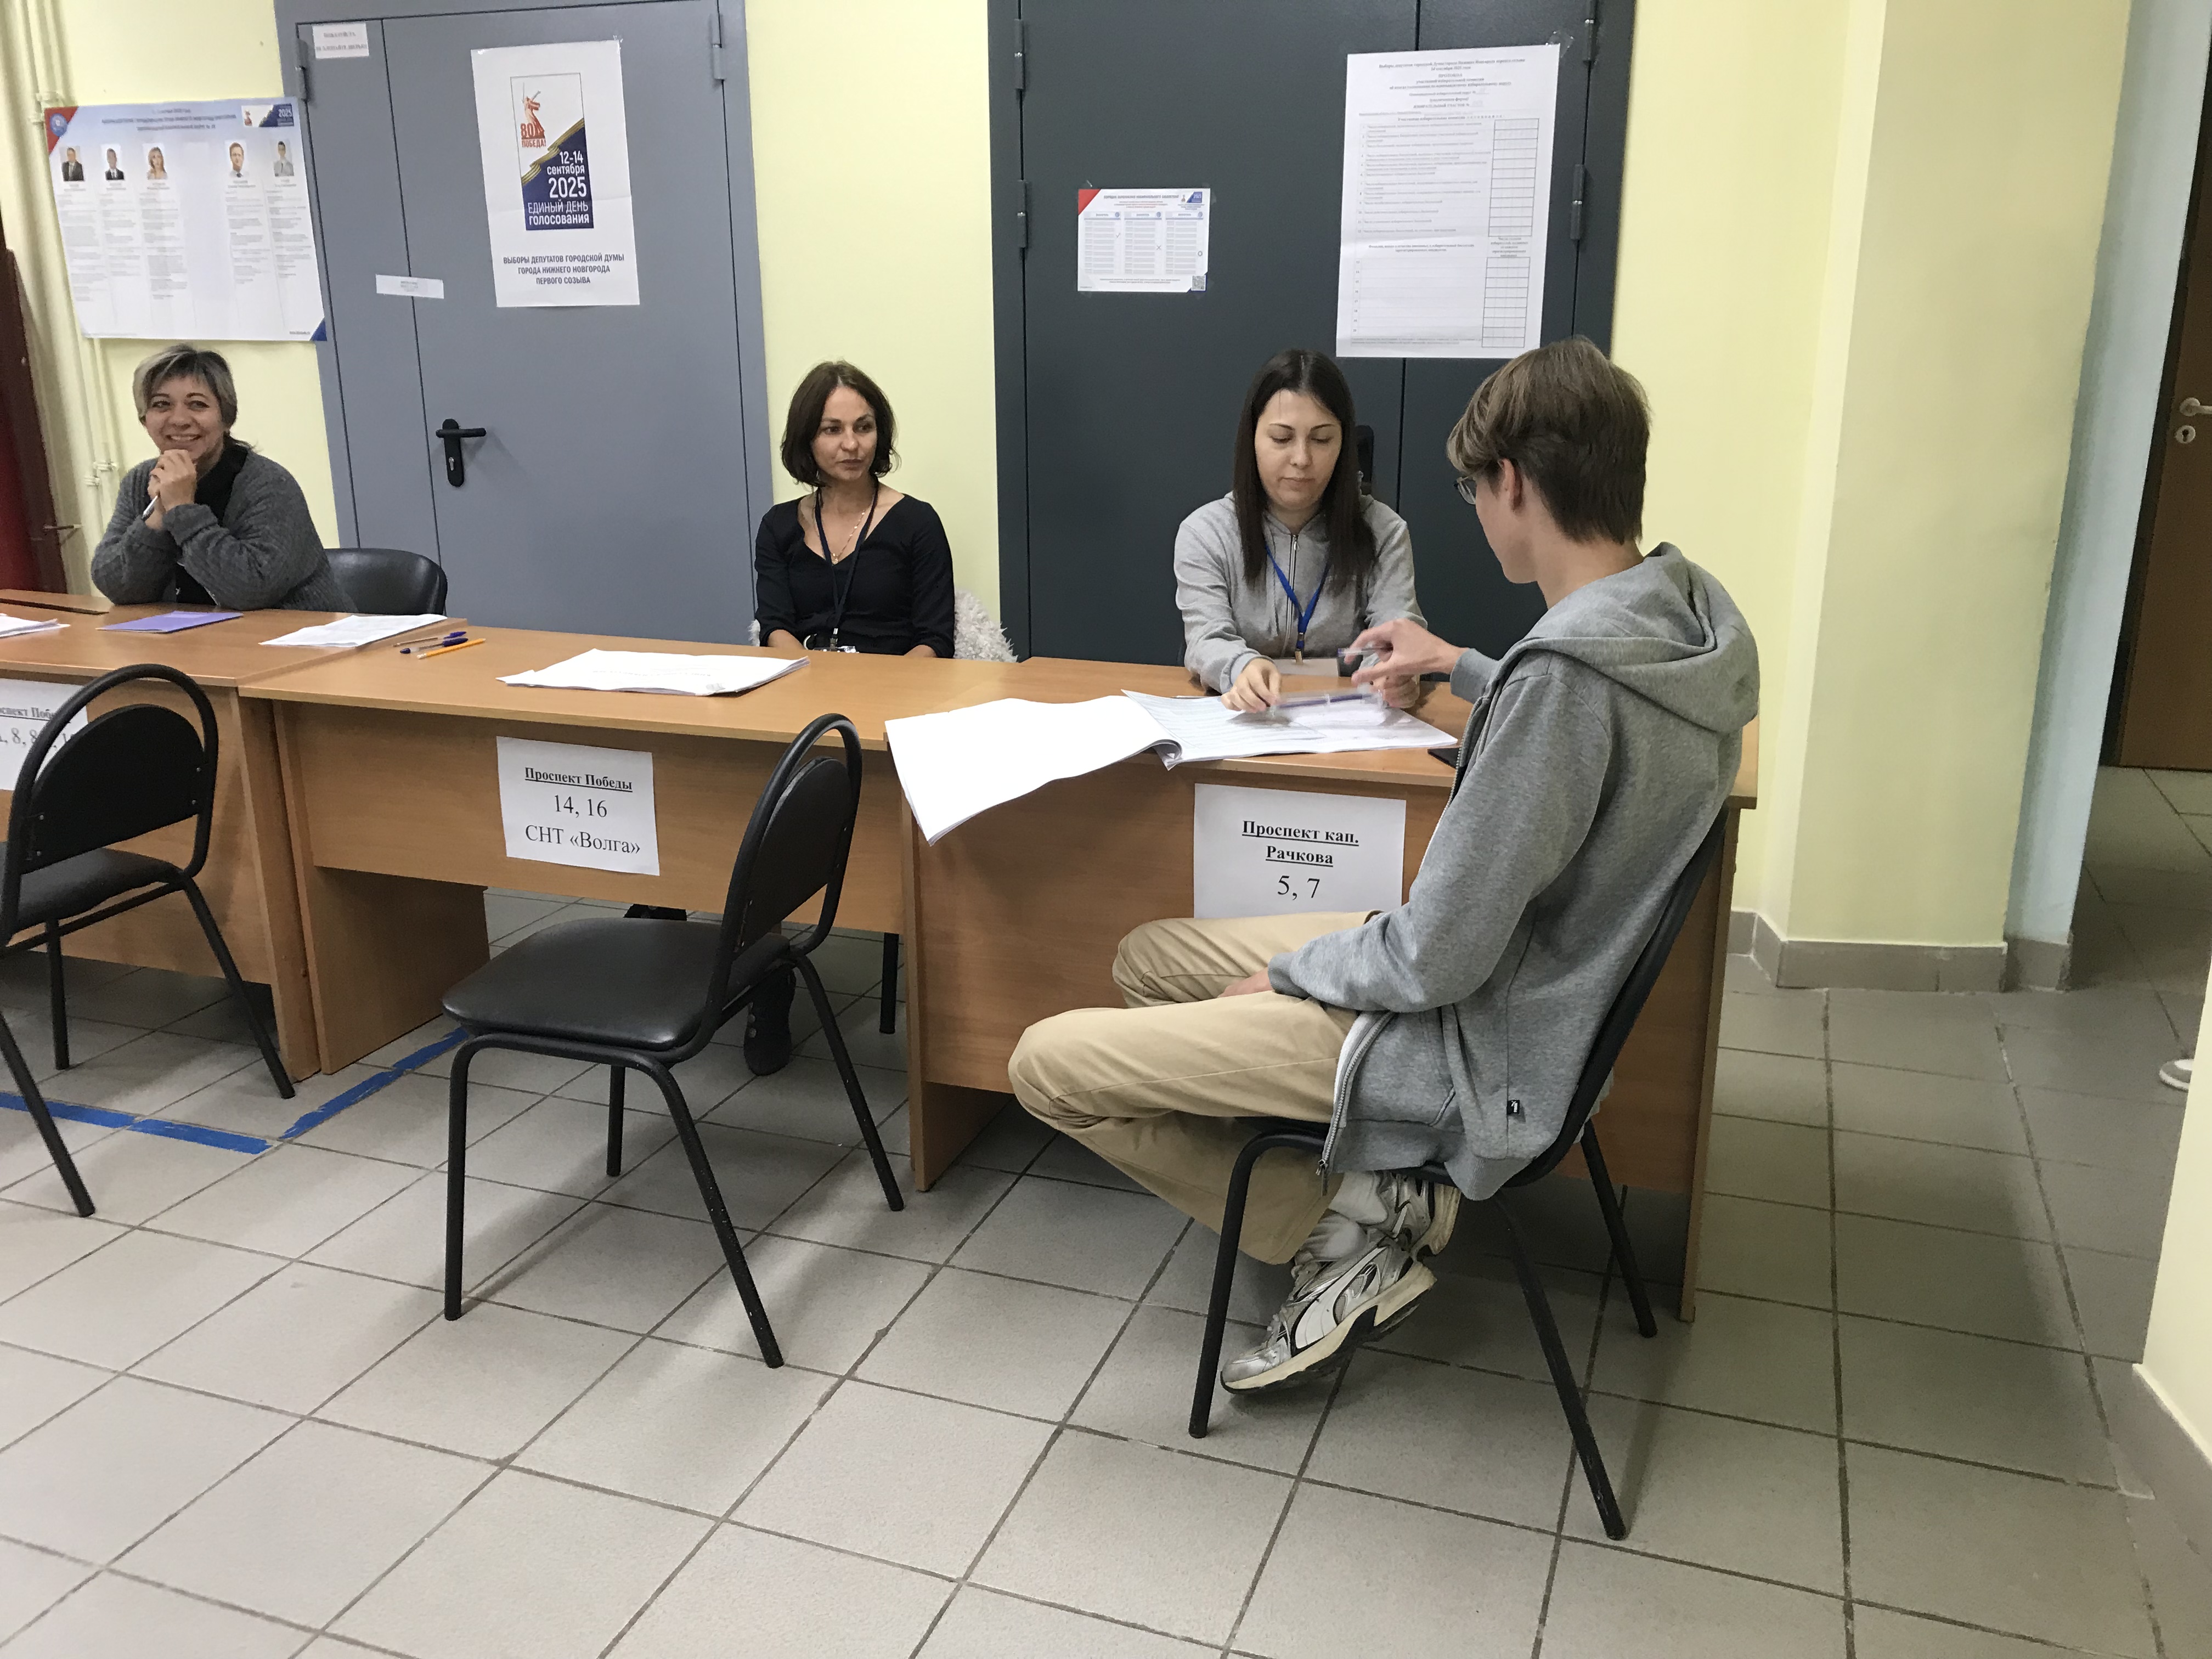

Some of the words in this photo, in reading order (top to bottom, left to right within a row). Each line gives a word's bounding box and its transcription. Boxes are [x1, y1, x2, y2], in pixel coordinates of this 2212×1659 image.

[522, 139, 546, 148] ПОБЕДА!
[560, 150, 584, 165] 12-14
[547, 163, 585, 176] сентября
[549, 176, 587, 199] 2025
[528, 199, 563, 214] ЕДИНЫЙ
[566, 200, 589, 213] ДЕНЬ
[529, 213, 590, 225] голосования
[531, 255, 564, 264] ДЕПУТАТОВ
[565, 252, 602, 263] ГОРОДСКОЙ
[604, 253, 624, 262] ДУМЫ
[518, 267, 541, 275] ГОРОДА
[573, 265, 610, 273] НОВГОРОДА
[525, 767, 582, 785] Проспект
[585, 774, 633, 791] Победы
[554, 794, 580, 818] 14,
[587, 798, 607, 817] 16
[526, 825, 564, 844] СНТ
[569, 831, 641, 854] «Волга»
[1242, 820, 1320, 839] Проспект
[1325, 831, 1359, 844] кап.
[1266, 845, 1333, 865] Рачкова
[1277, 875, 1297, 900] 5,
[1307, 878, 1320, 899] 7
